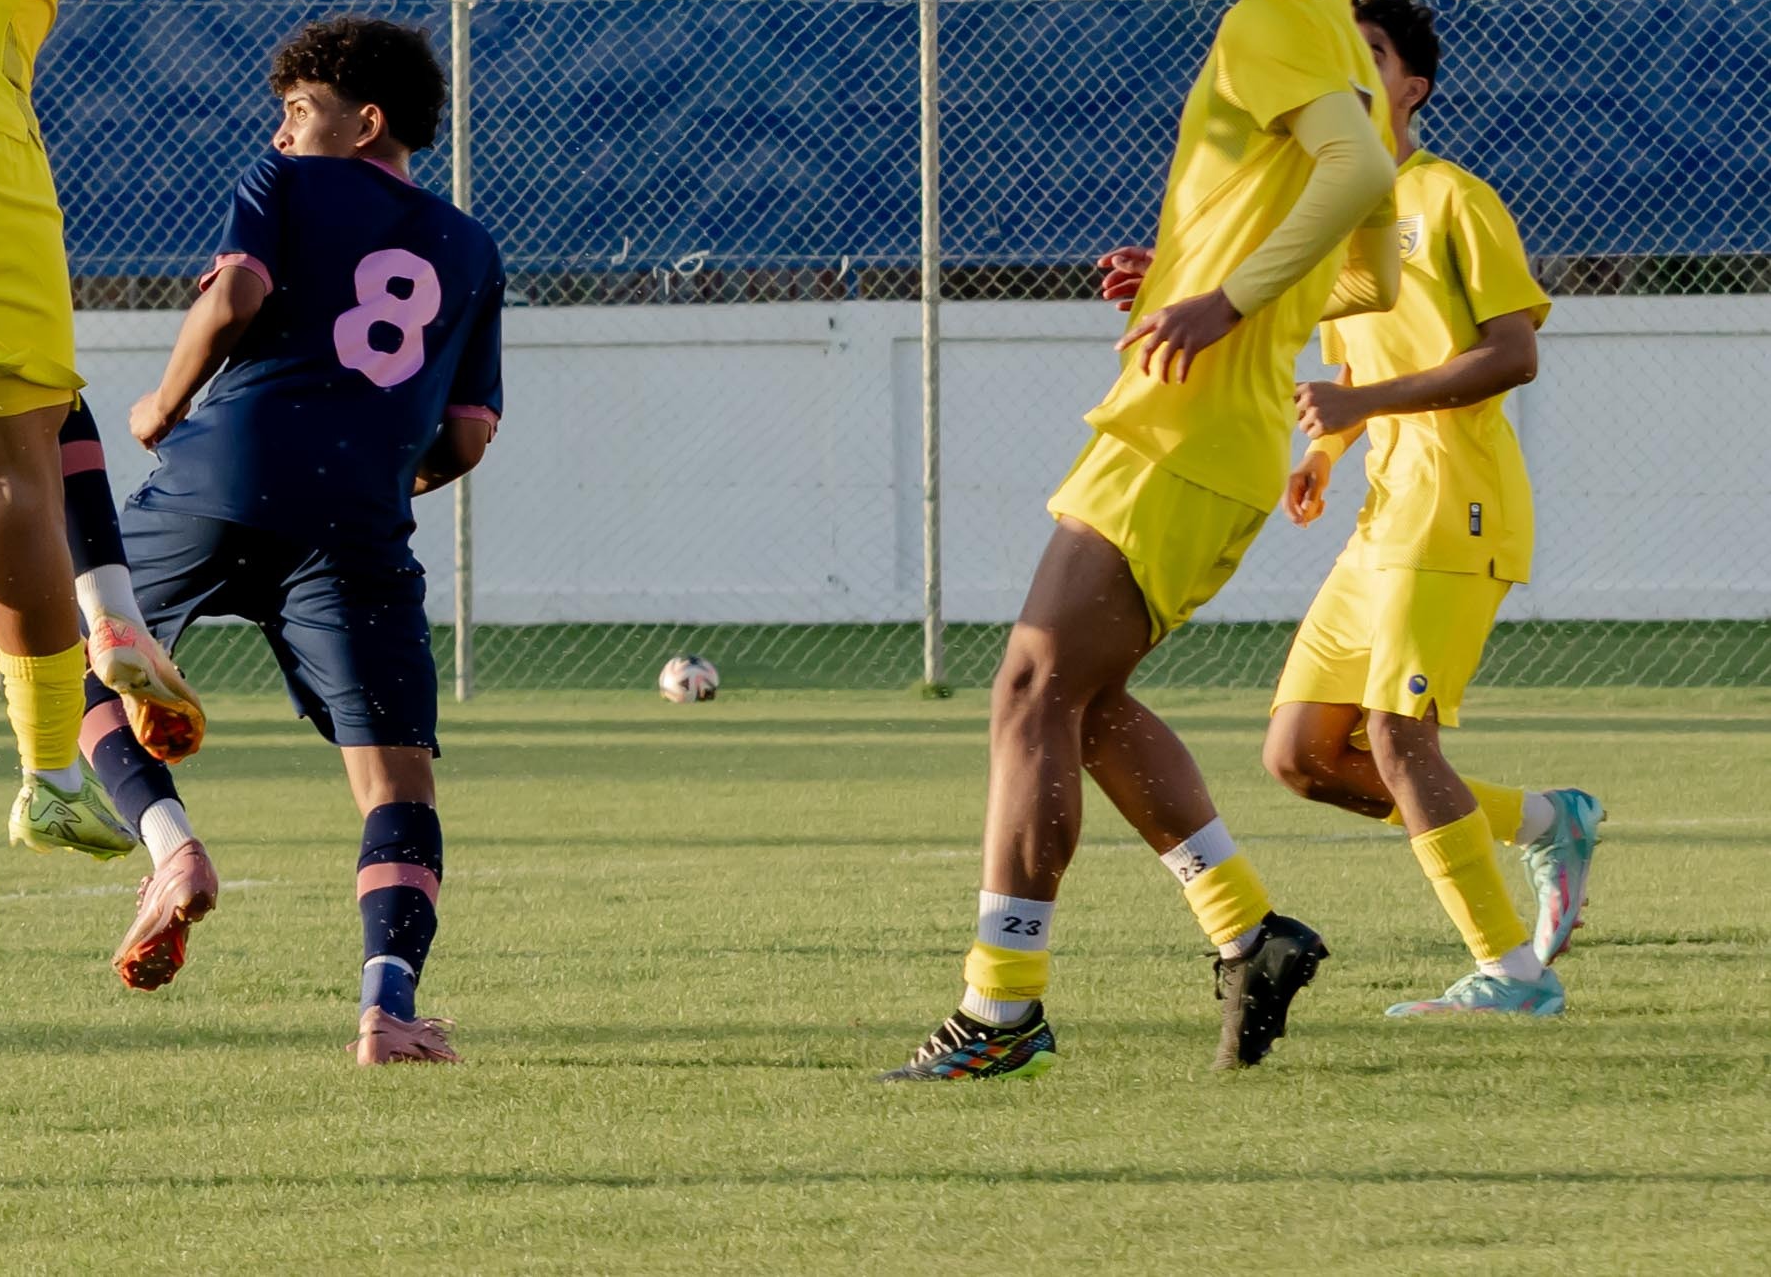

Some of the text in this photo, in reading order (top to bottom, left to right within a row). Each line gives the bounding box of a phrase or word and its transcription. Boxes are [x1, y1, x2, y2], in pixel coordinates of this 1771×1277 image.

[333, 248, 441, 387] 8
[1179, 855, 1207, 882] 23
[1002, 916, 1042, 936] 23
